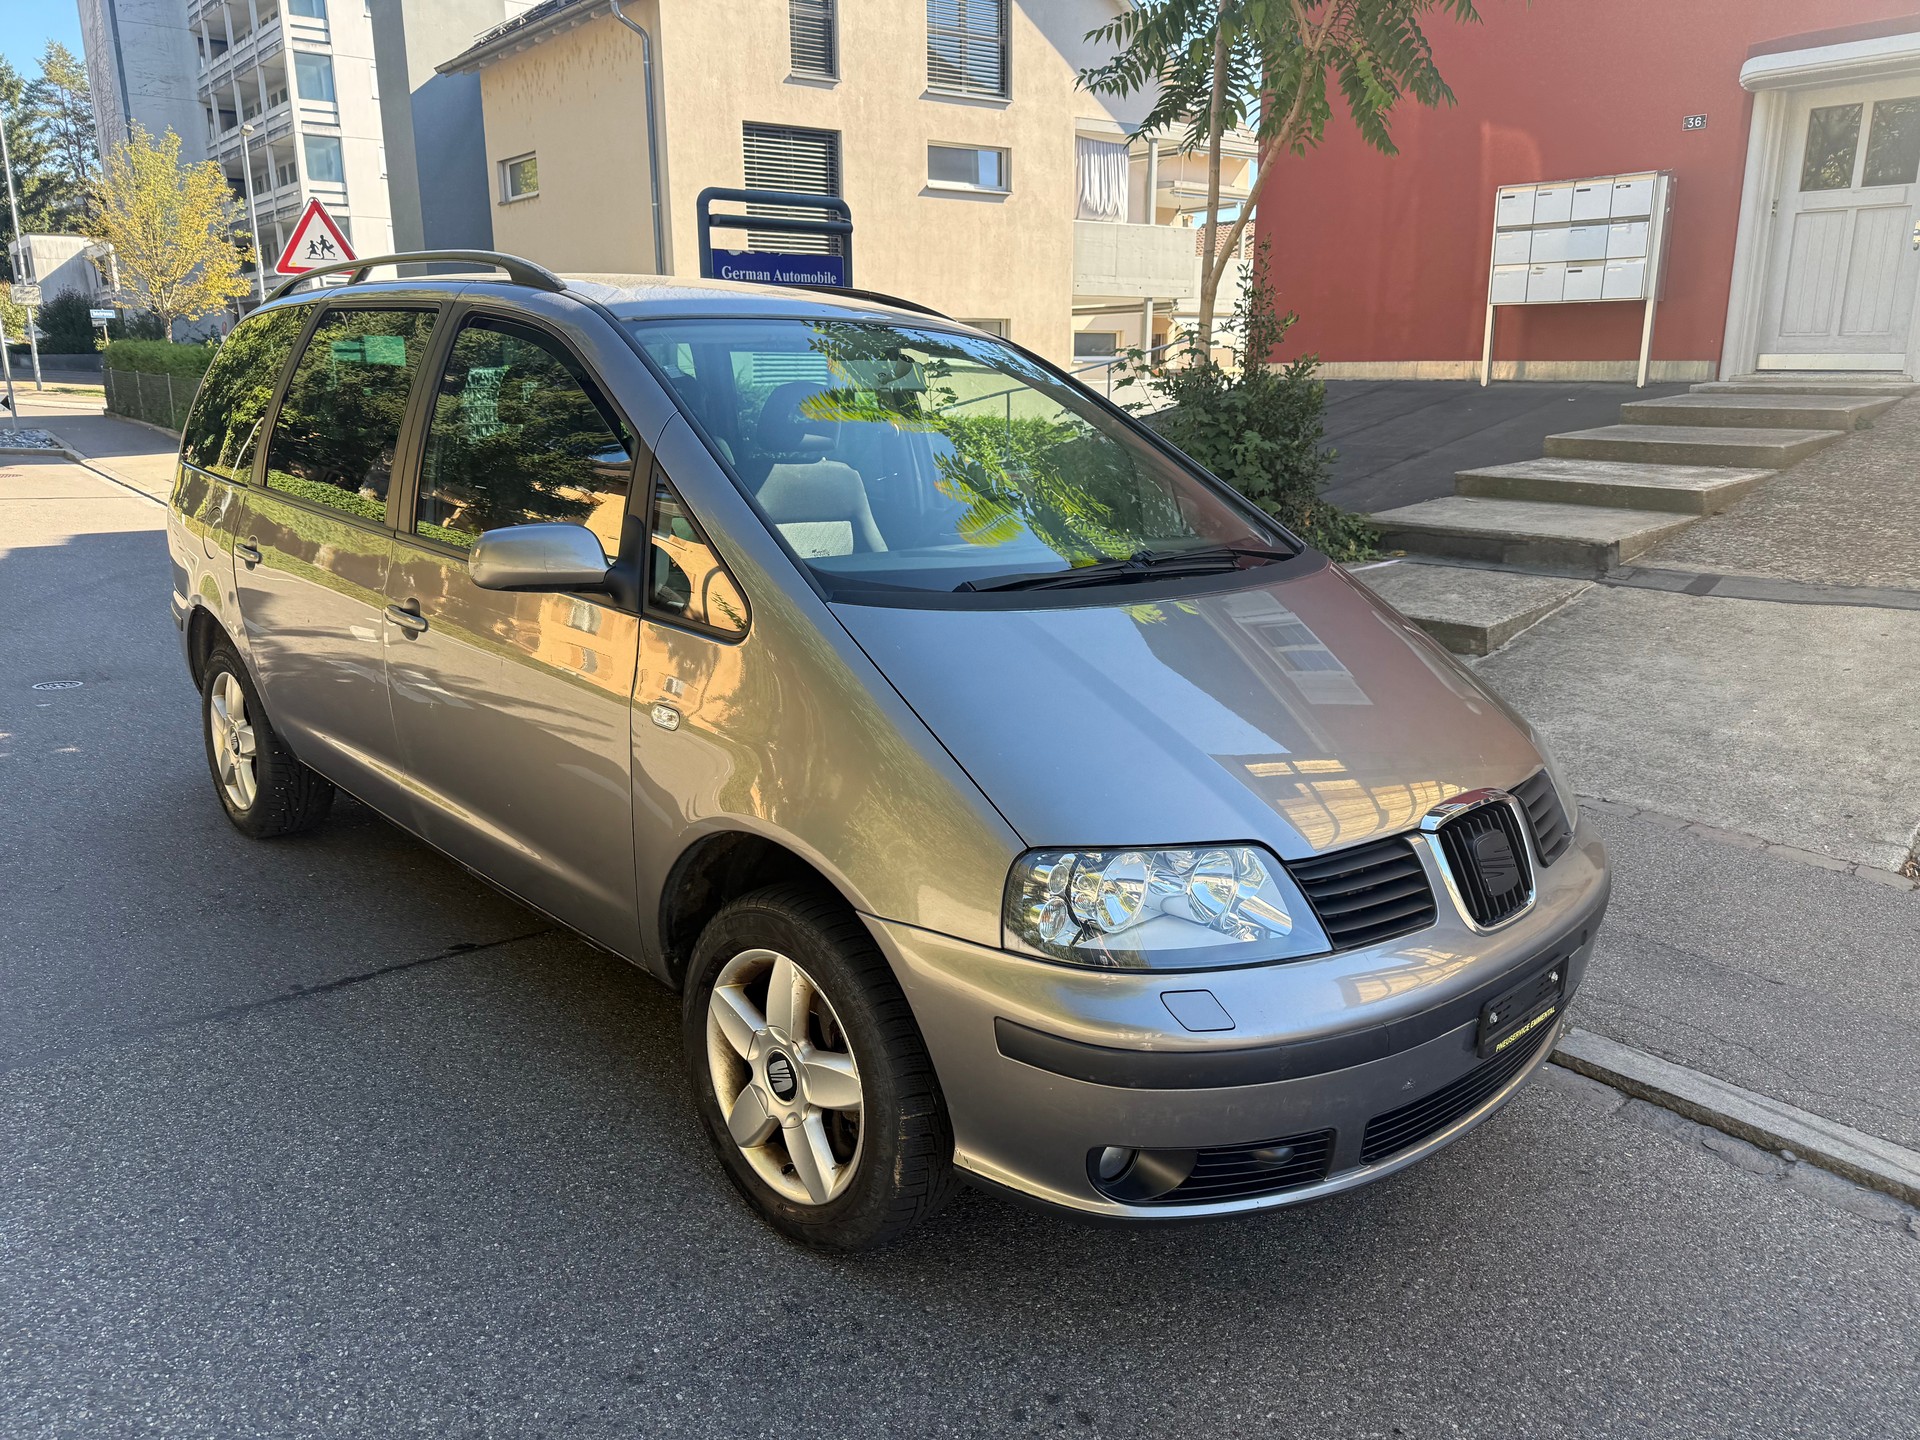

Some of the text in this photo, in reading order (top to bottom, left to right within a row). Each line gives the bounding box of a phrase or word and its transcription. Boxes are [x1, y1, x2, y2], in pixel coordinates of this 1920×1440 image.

[1687, 116, 1702, 128] 36
[721, 265, 837, 284] German Automobile
